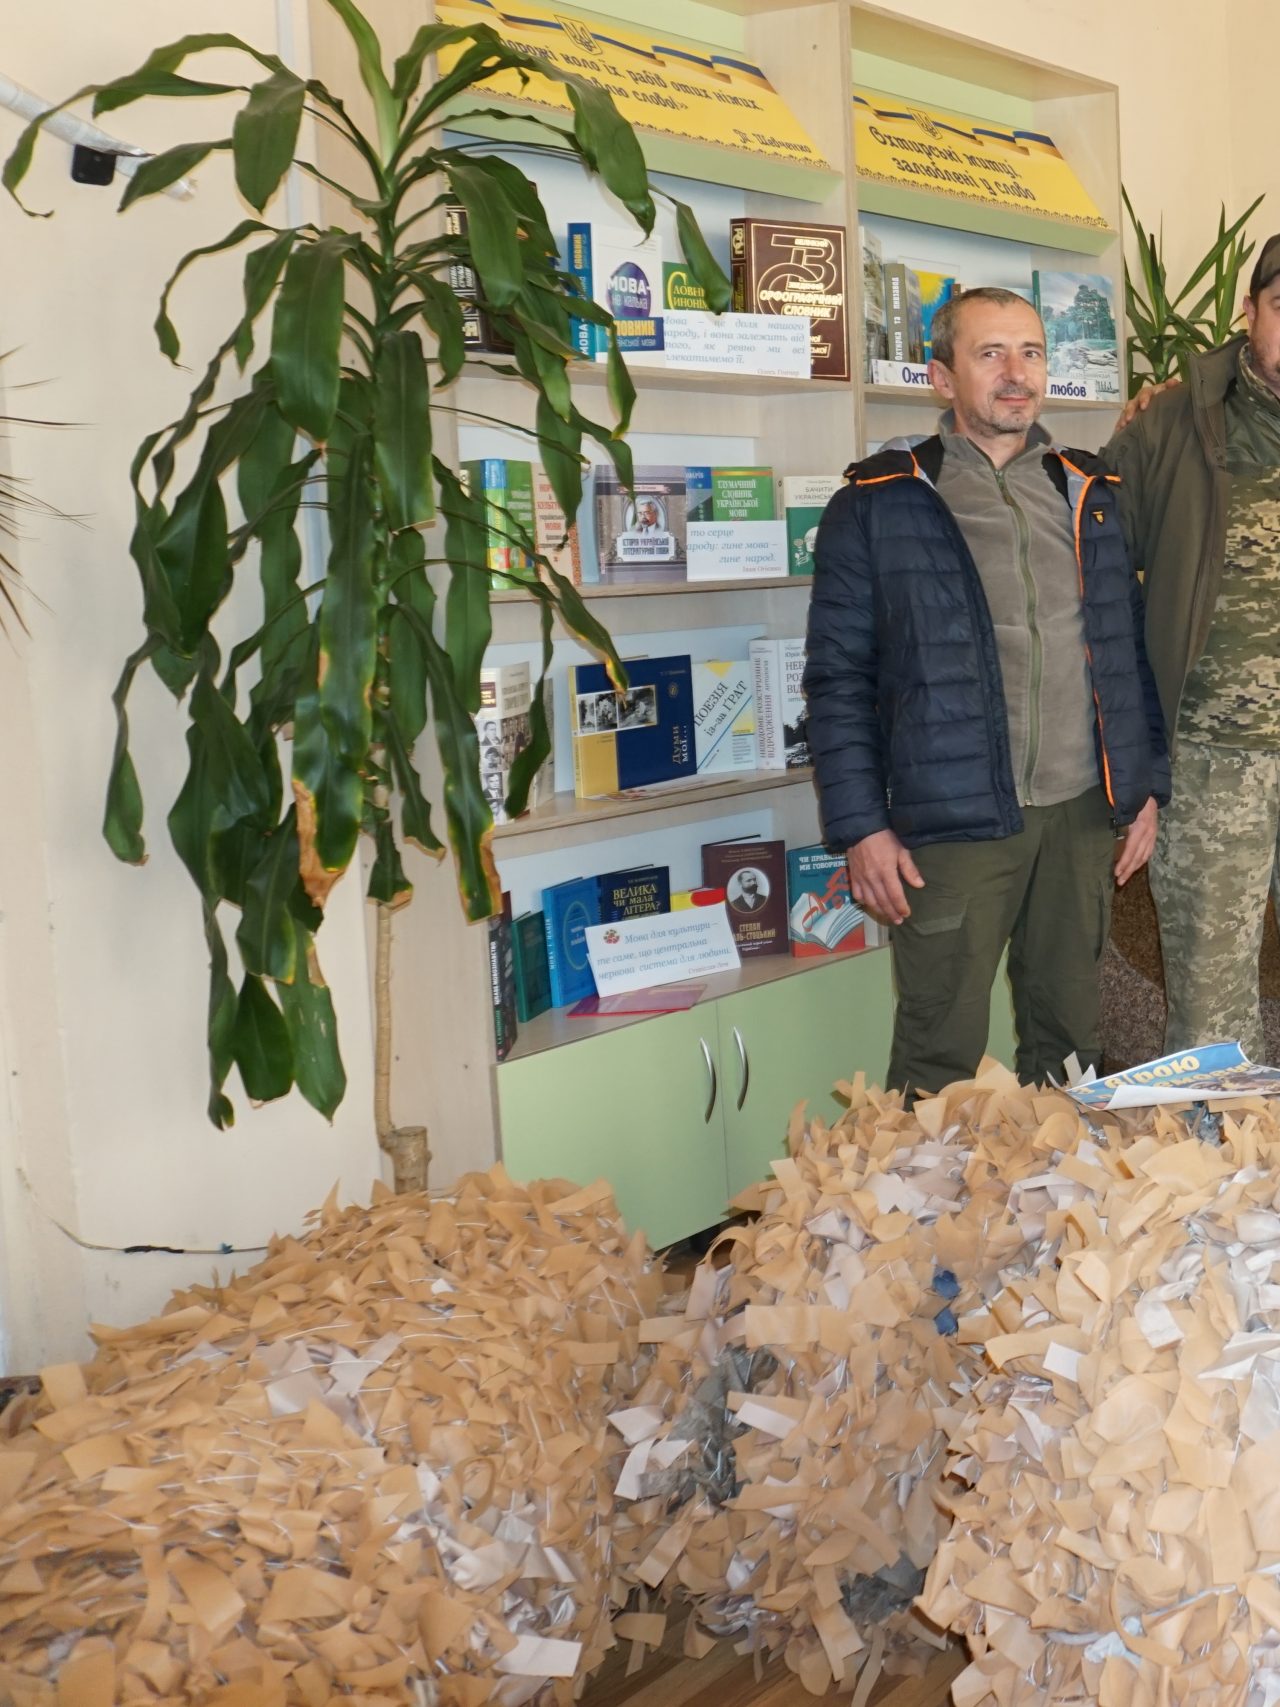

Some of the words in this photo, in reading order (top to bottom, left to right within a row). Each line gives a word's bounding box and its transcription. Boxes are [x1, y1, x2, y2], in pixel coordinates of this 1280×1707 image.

[560, 52, 600, 72] коло
[626, 69, 668, 89] рабів
[671, 80, 713, 100] отих
[752, 132, 812, 153] Шевченко
[868, 125, 963, 164] Охтирські
[891, 157, 981, 189] залюблені
[979, 177, 998, 196] у
[994, 180, 1037, 201] слово
[607, 276, 651, 295] МОВА-
[783, 304, 832, 318] СЛОВНИК
[1050, 381, 1087, 398] любов
[805, 486, 834, 494] БАЧИТИ
[728, 509, 748, 518] МОВИ
[707, 529, 735, 540] серце
[721, 542, 743, 550] гине
[718, 555, 741, 563] гине
[693, 682, 729, 728] ПОЕЗІЯ
[799, 863, 811, 871] МИ
[613, 883, 658, 899] ВЕЛИКА
[624, 934, 649, 945] Мова
[650, 929, 666, 940] для
[667, 920, 711, 937] культури
[654, 938, 708, 957] центральна
[599, 966, 636, 980] нервова
